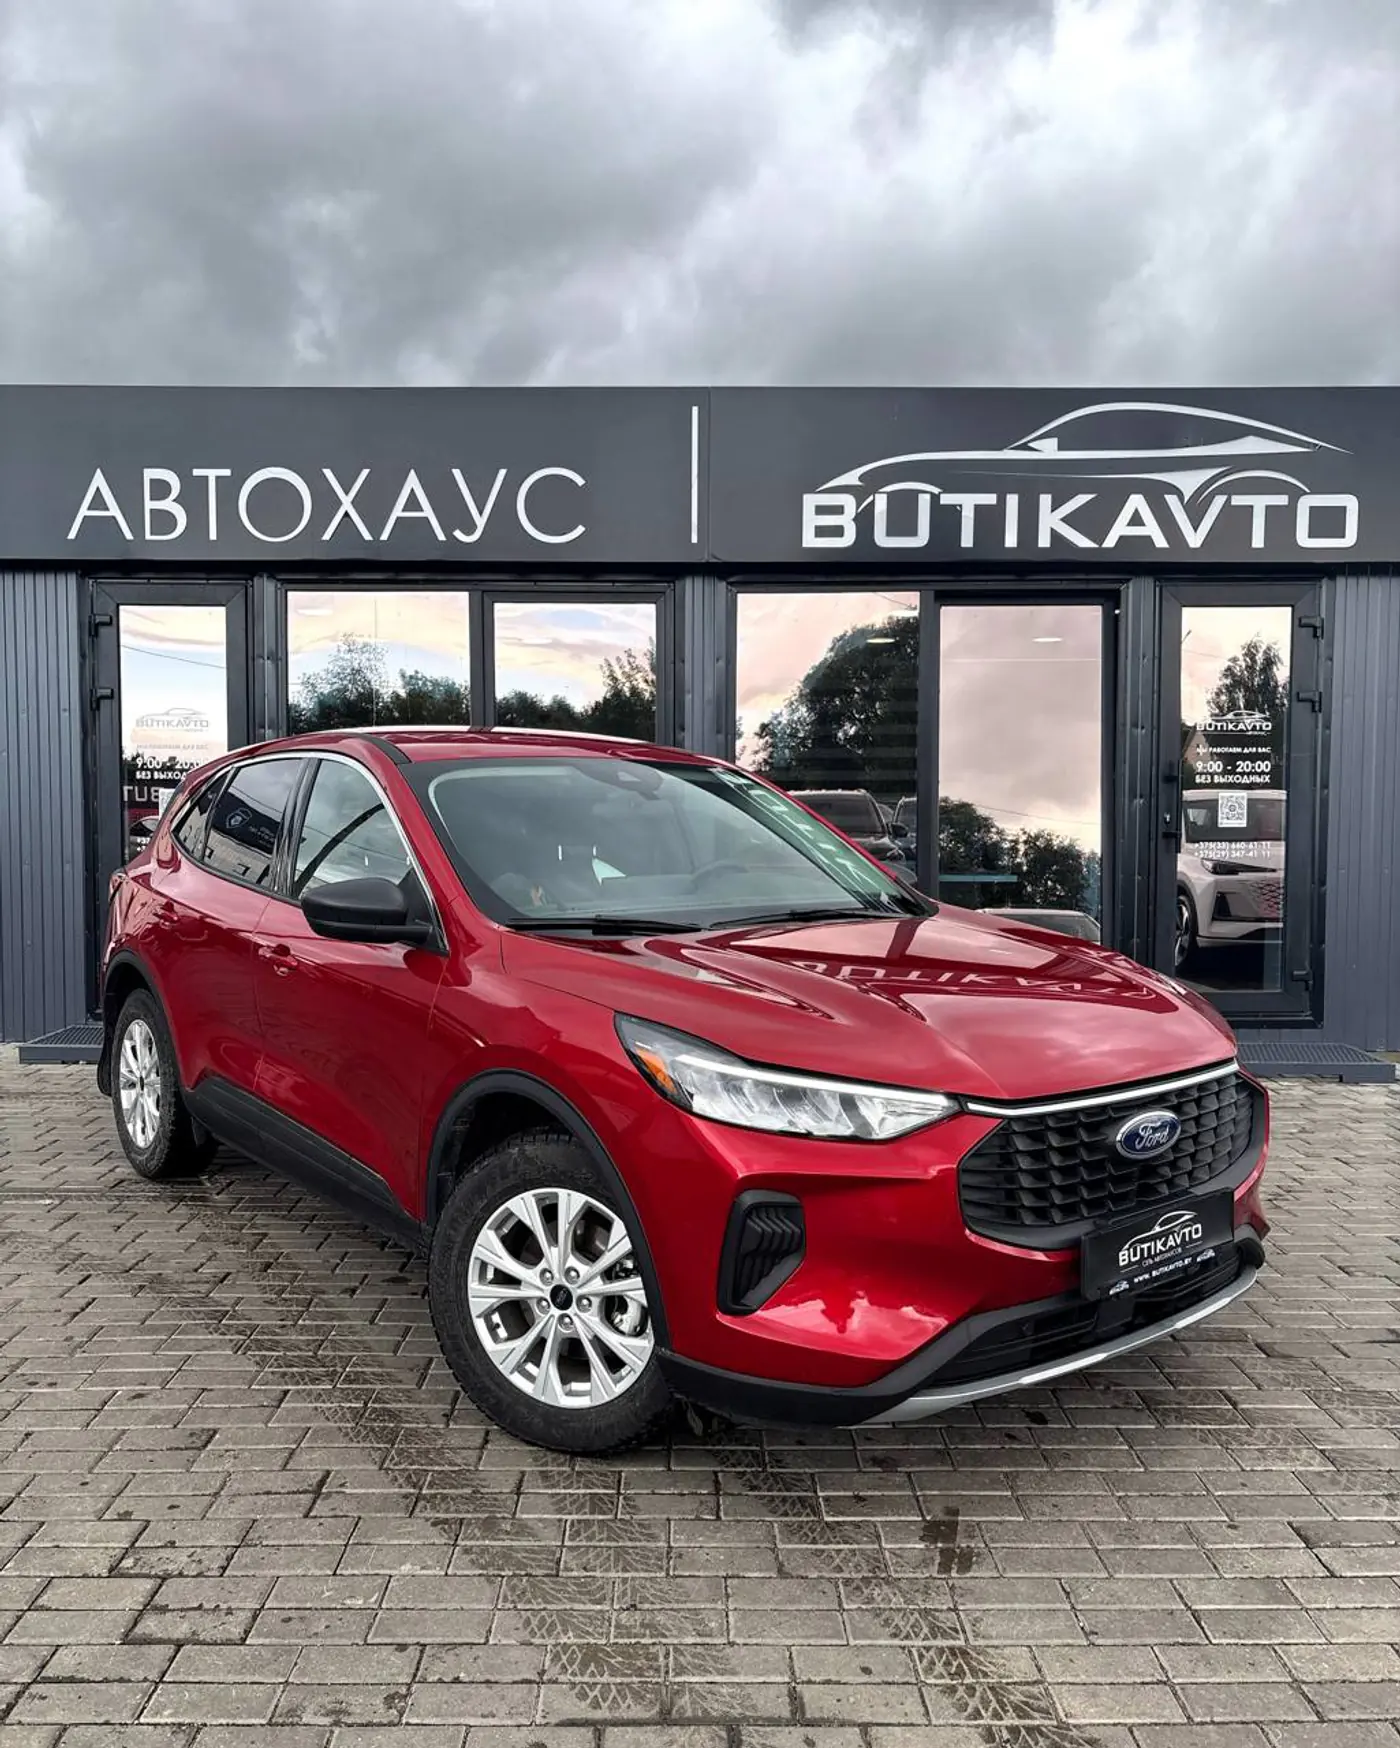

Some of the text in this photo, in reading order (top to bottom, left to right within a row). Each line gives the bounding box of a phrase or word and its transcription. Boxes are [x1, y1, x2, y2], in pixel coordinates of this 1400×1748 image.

[66, 466, 587, 544] АВТОХАУС
[801, 492, 1360, 549] BUTIKAVTO
[136, 718, 209, 728] BUTIKAVTO
[1196, 721, 1272, 731] BUTIKAVTO
[136, 756, 162, 769] 9:00
[1196, 760, 1223, 773] 9:00
[1235, 760, 1272, 773] 20:00
[136, 771, 152, 780] БЕЗ
[1195, 774, 1271, 784] БЕЗ ВЫХОДНЫХ
[1134, 1120, 1170, 1150] Ford
[1118, 1223, 1202, 1266] BUTIKAVTO
